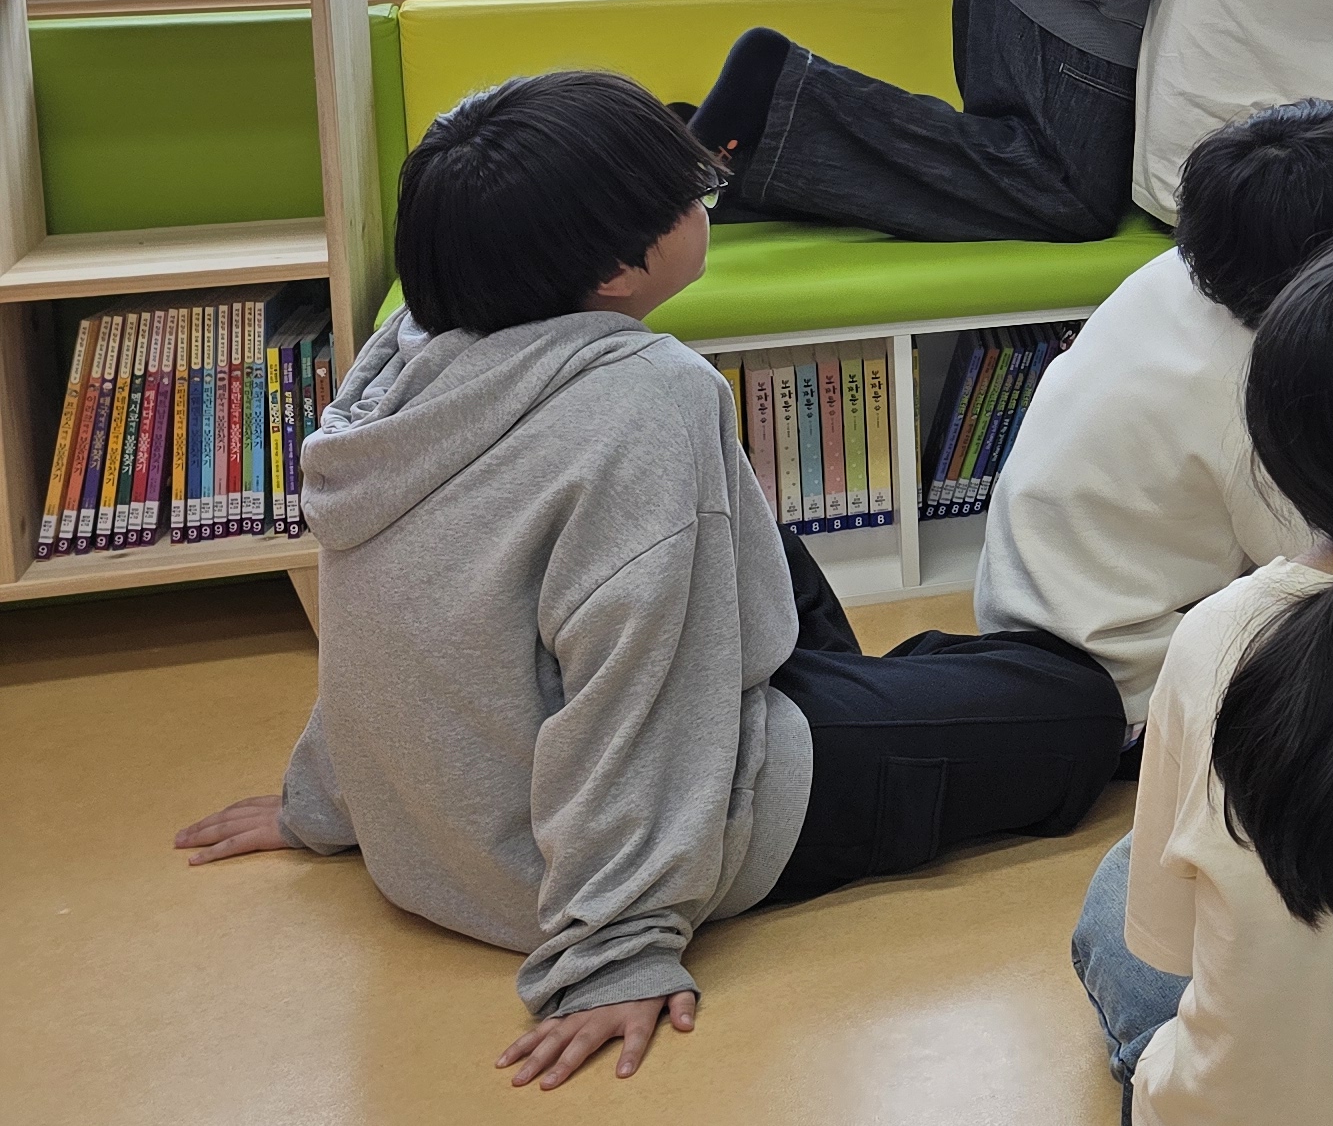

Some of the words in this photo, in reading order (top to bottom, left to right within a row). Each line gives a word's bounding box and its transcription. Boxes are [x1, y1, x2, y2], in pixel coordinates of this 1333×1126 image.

[230, 381, 241, 424] 폴란드에서
[127, 393, 142, 433] 멕시코에서
[142, 390, 156, 433] 캐나다에서
[230, 424, 241, 463] 보물찾기
[122, 435, 137, 476] 보물찾기
[135, 433, 150, 474] 보물찾기
[926, 506, 935, 517] 8
[938, 505, 947, 516] 8
[951, 504, 960, 514] 8
[962, 503, 971, 513] 8
[974, 501, 982, 511] 8
[834, 519, 842, 529] 8
[855, 517, 863, 526] 8
[877, 514, 885, 524] 8
[214, 524, 223, 535] 9
[229, 521, 238, 532] 9
[243, 519, 251, 531] 9
[253, 521, 262, 532] 9
[275, 520, 285, 531] 9
[290, 524, 299, 535] 9
[812, 522, 820, 532] 8
[128, 531, 137, 542] 9
[143, 530, 152, 541] 9
[172, 529, 181, 540] 9
[188, 528, 197, 539] 9
[202, 526, 210, 537] 9
[77, 538, 86, 550] 9
[97, 536, 106, 547] 9
[115, 534, 124, 545] 9
[39, 545, 47, 556] 9
[59, 540, 68, 551] 9
